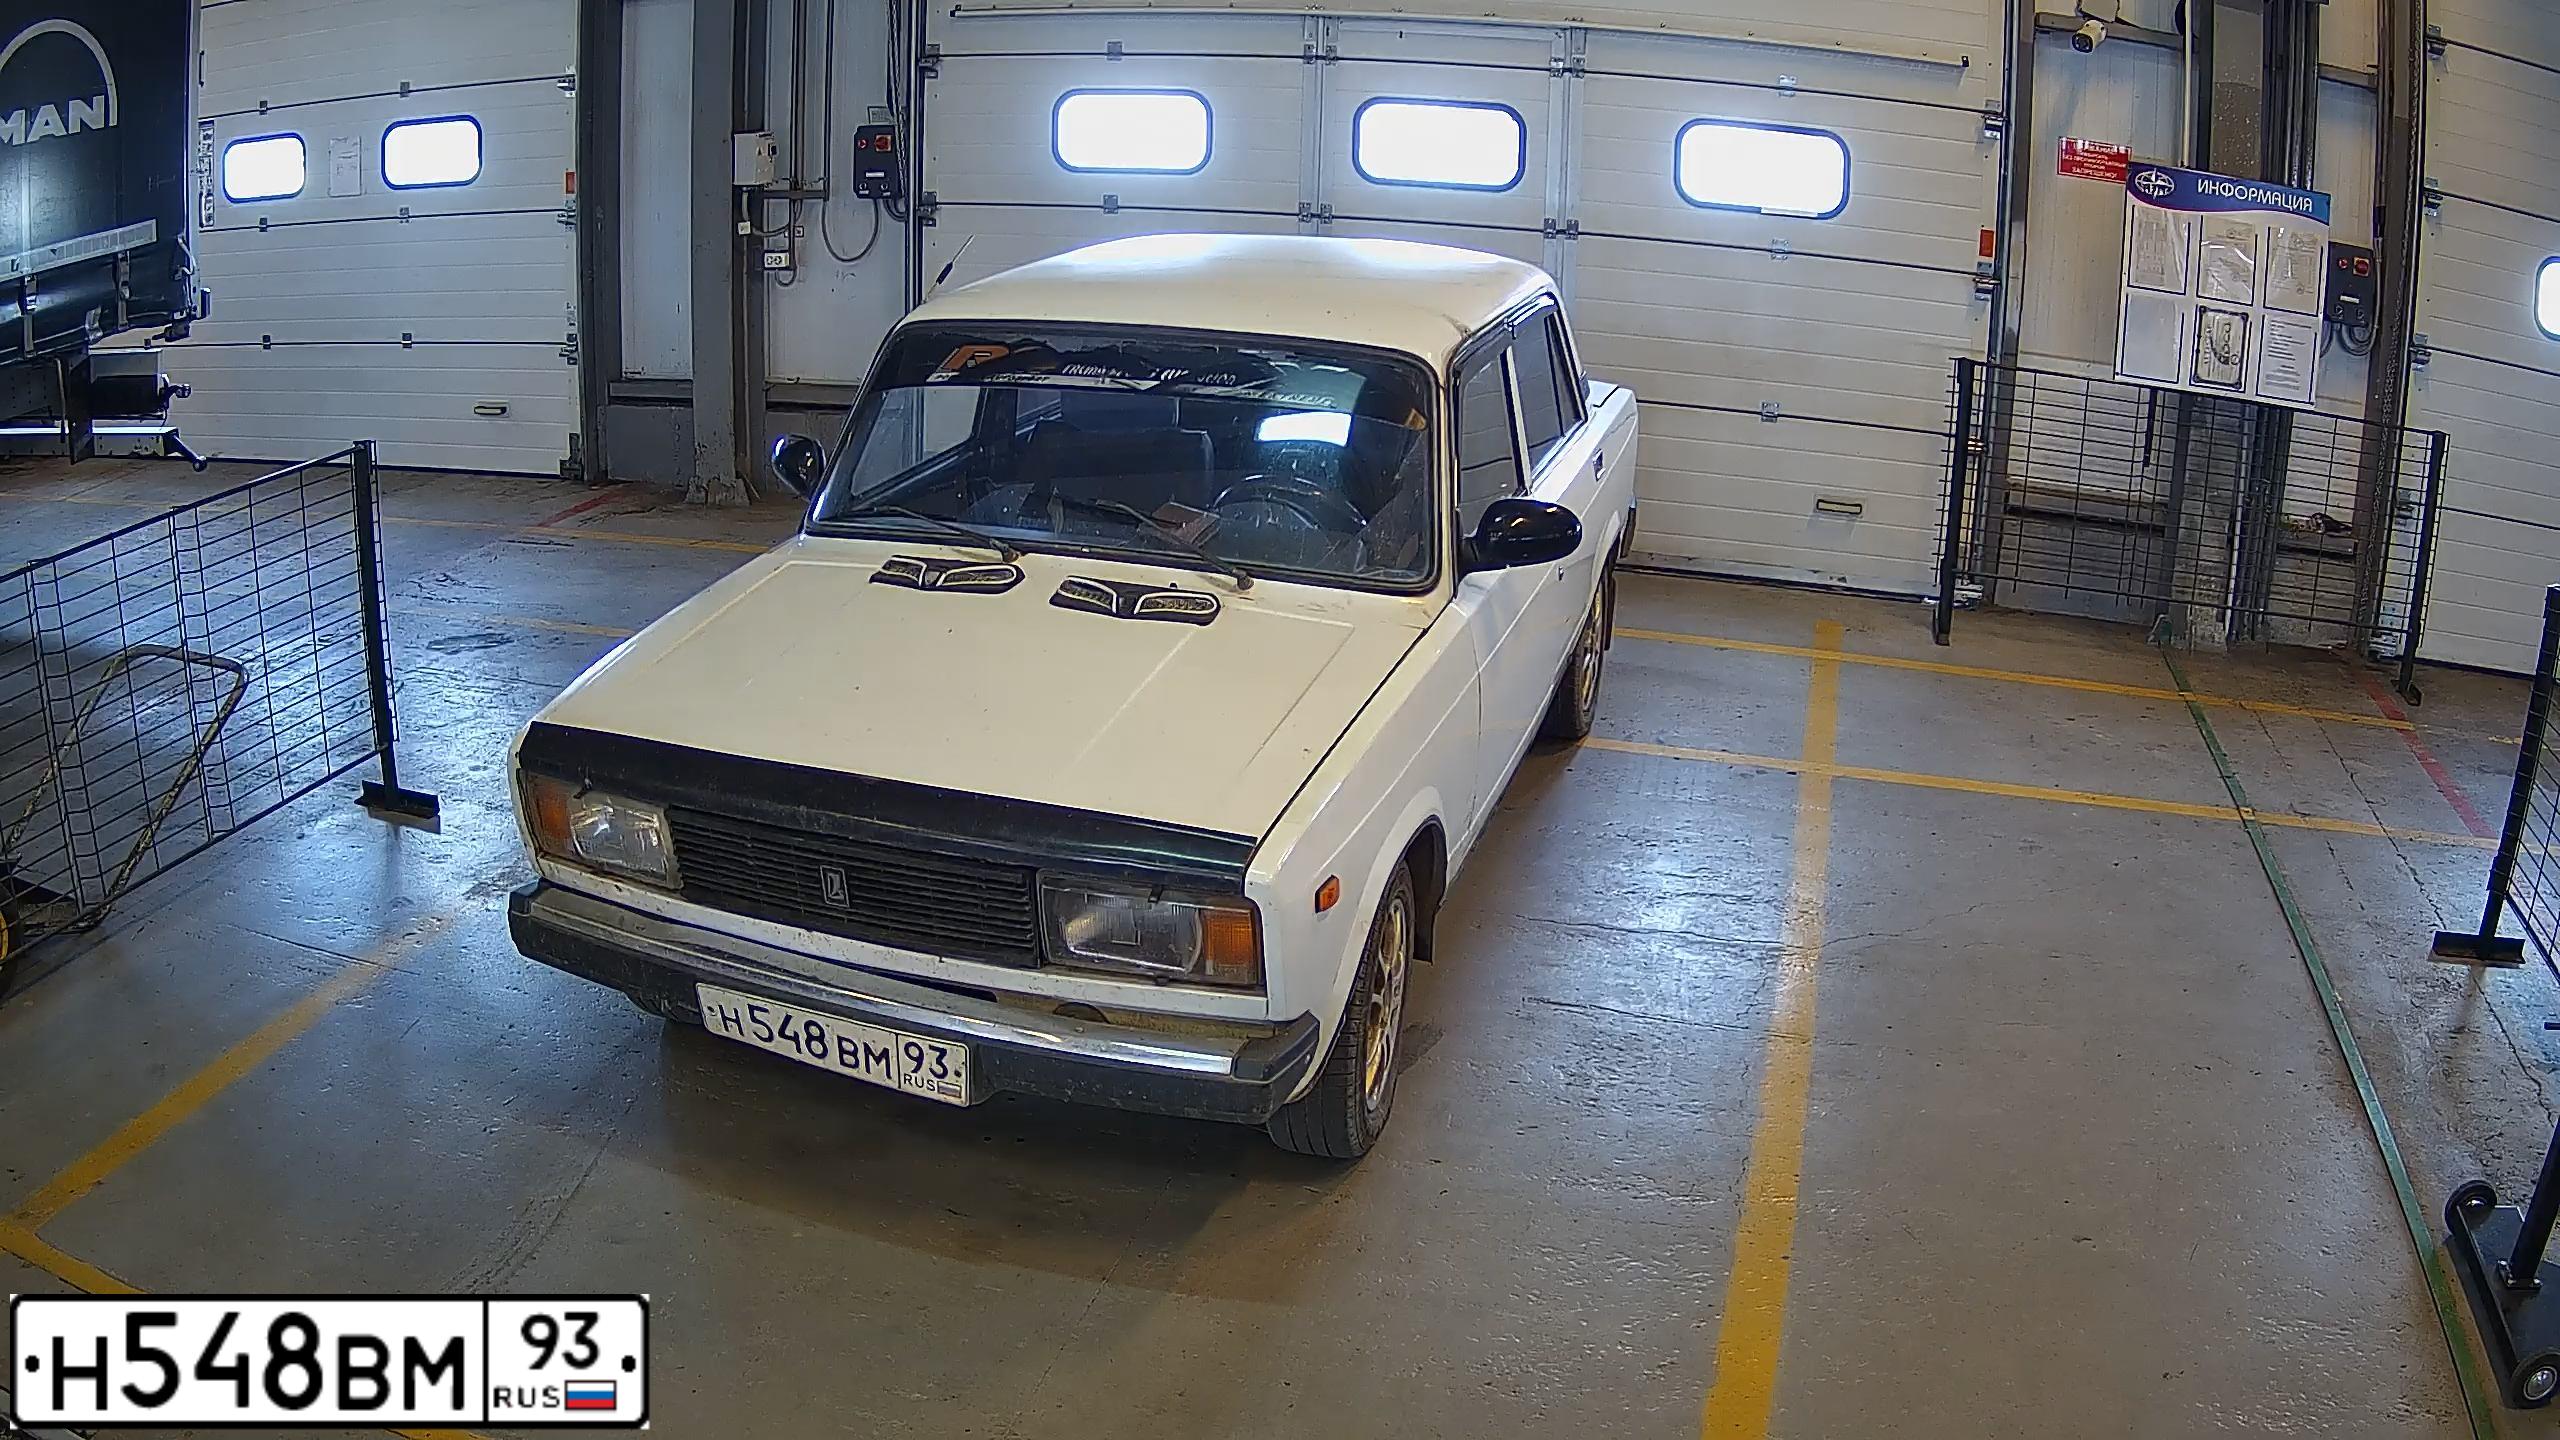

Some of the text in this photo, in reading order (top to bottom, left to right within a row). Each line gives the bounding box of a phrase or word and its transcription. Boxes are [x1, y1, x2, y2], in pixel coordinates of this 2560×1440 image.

[0, 95, 105, 146] MAN
[2197, 178, 2313, 213] ИНФОРМАЦИЯ
[903, 1040, 949, 1080] 93
[903, 1072, 937, 1093] RUS
